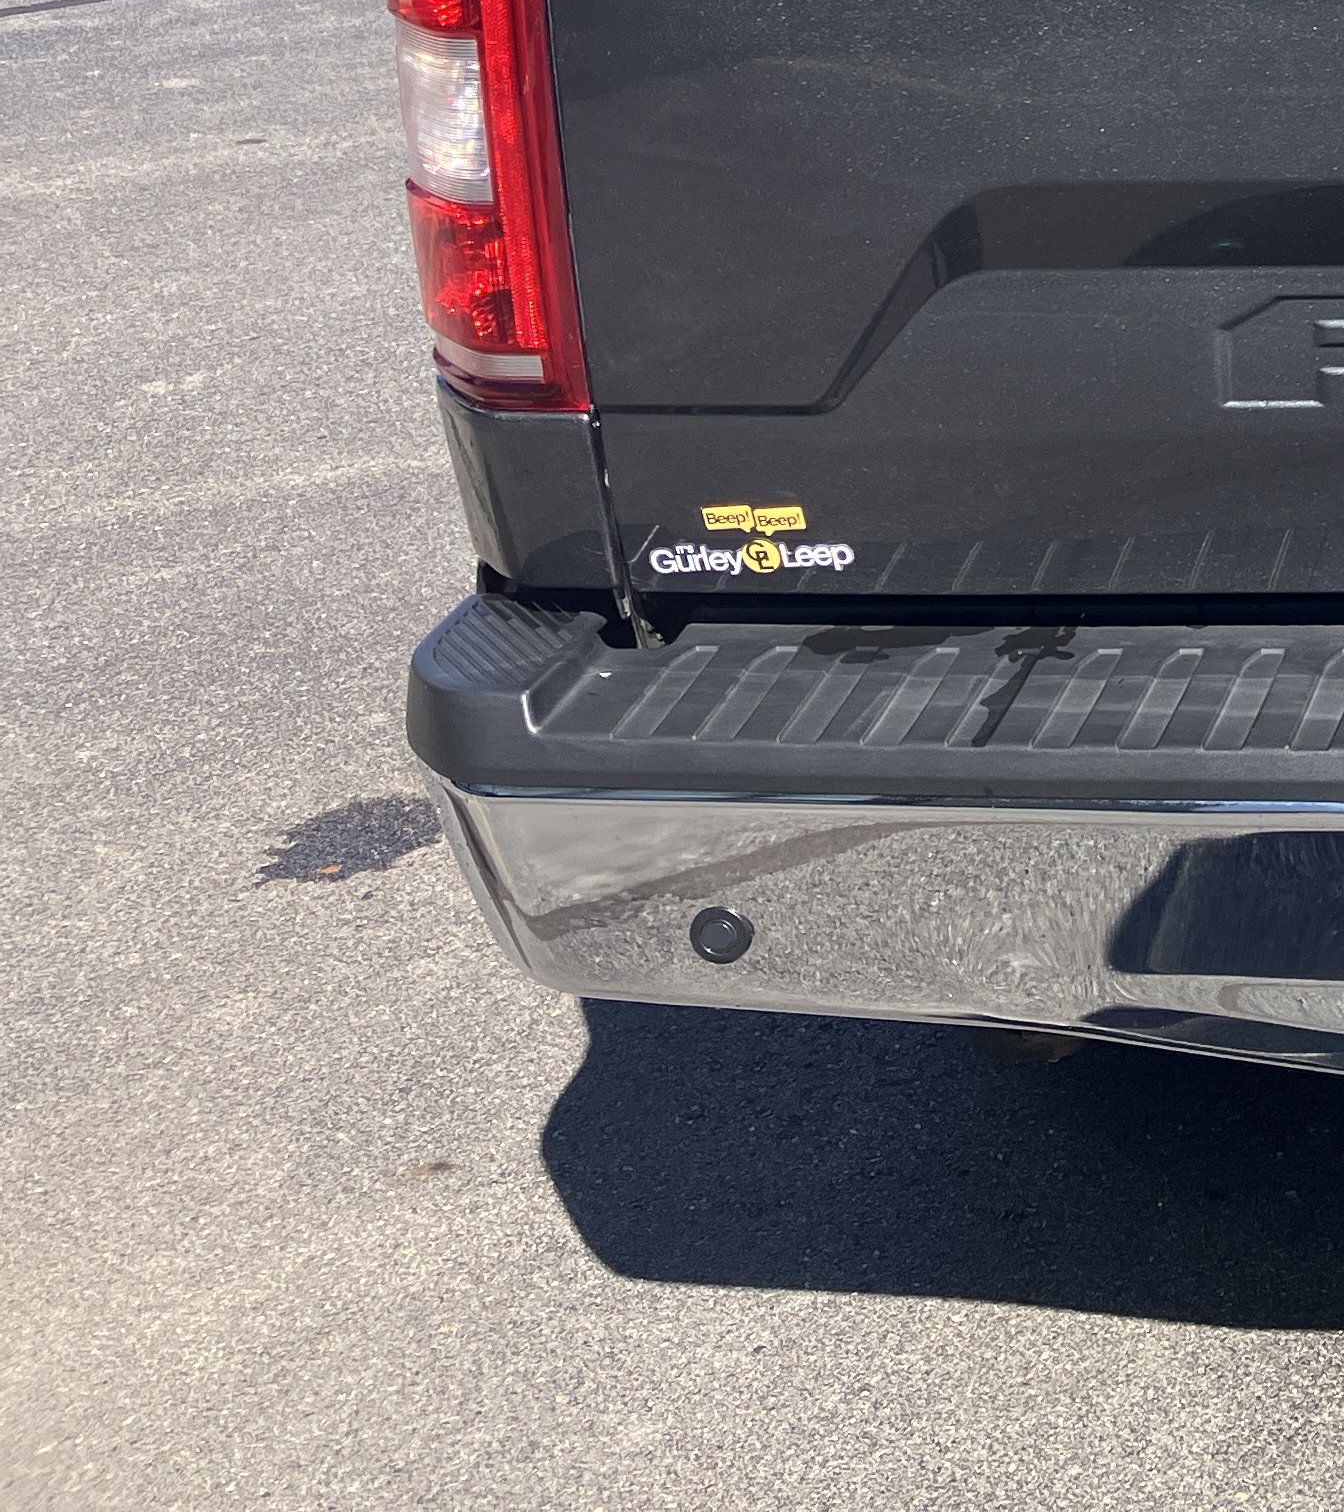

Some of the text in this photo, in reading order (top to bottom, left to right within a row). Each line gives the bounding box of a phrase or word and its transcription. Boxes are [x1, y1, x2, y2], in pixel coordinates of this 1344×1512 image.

[705, 510, 802, 528] Beep! Beep!
[650, 544, 743, 575] Gurley
[779, 543, 855, 572] Leep
